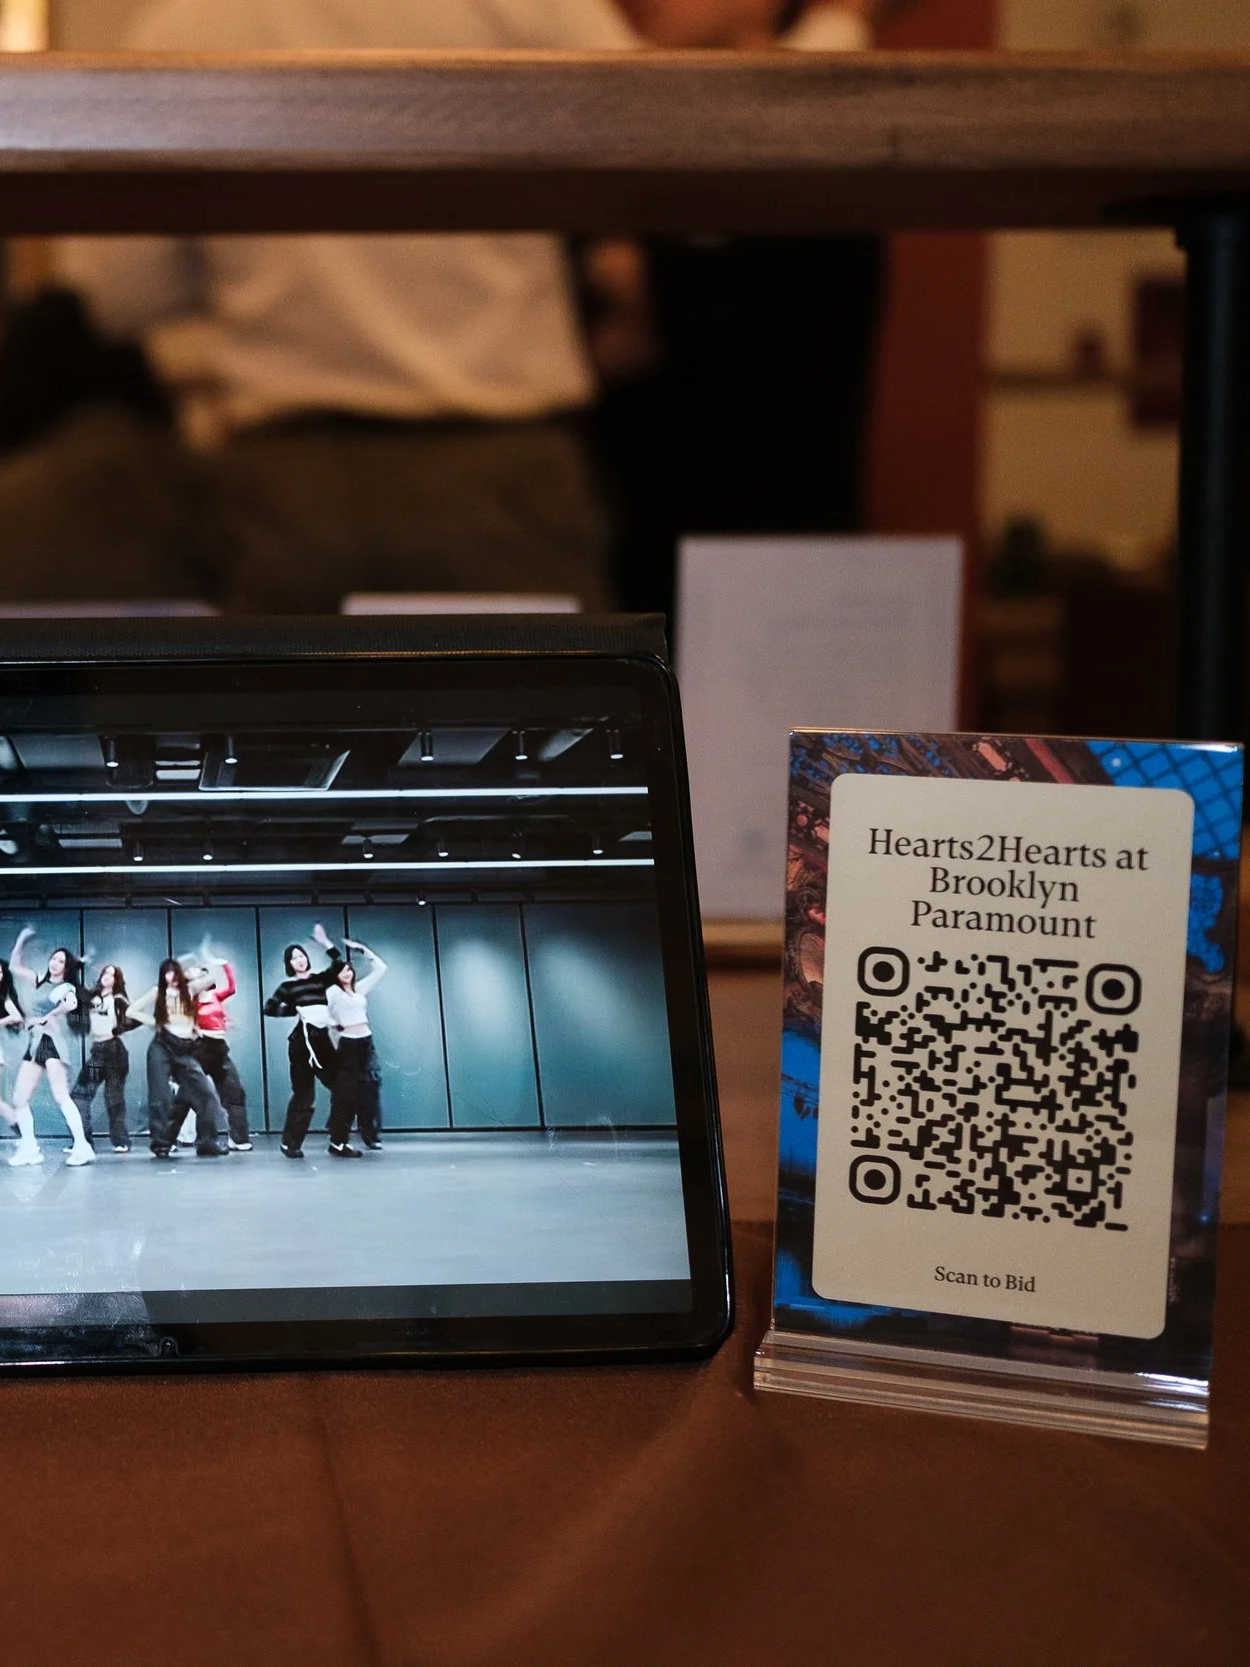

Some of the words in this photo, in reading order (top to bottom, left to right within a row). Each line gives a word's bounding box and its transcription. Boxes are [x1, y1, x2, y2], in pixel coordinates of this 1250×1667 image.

[868, 827, 1107, 869] Hearts2Hearts
[1115, 847, 1149, 871] at
[929, 866, 1079, 909] Brooklyn
[910, 899, 1097, 939] Paramount
[934, 1265, 979, 1286] Scan
[982, 1274, 1002, 1289] to
[1005, 1274, 1036, 1293] Bid
